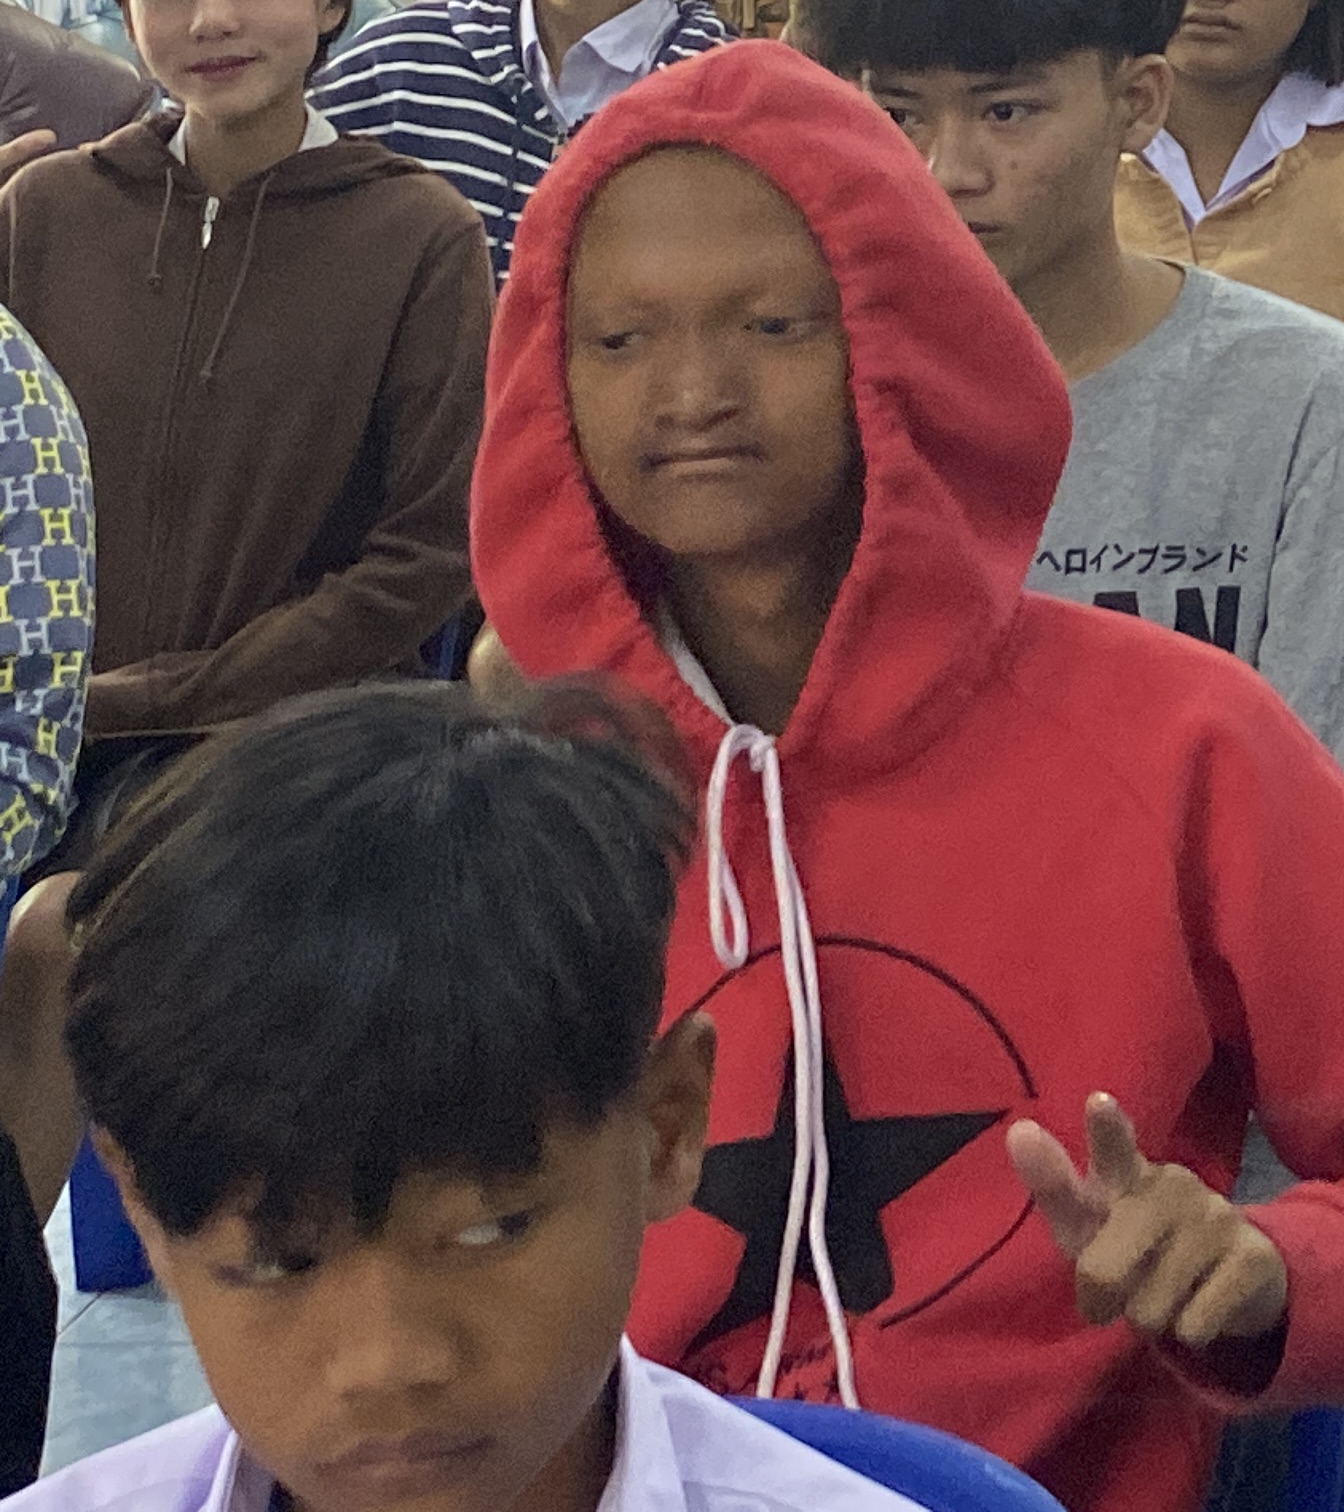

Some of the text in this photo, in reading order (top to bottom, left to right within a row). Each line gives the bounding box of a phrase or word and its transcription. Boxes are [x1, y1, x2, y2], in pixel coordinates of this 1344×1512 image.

[1036, 543, 1249, 576] ヘロインブランド
